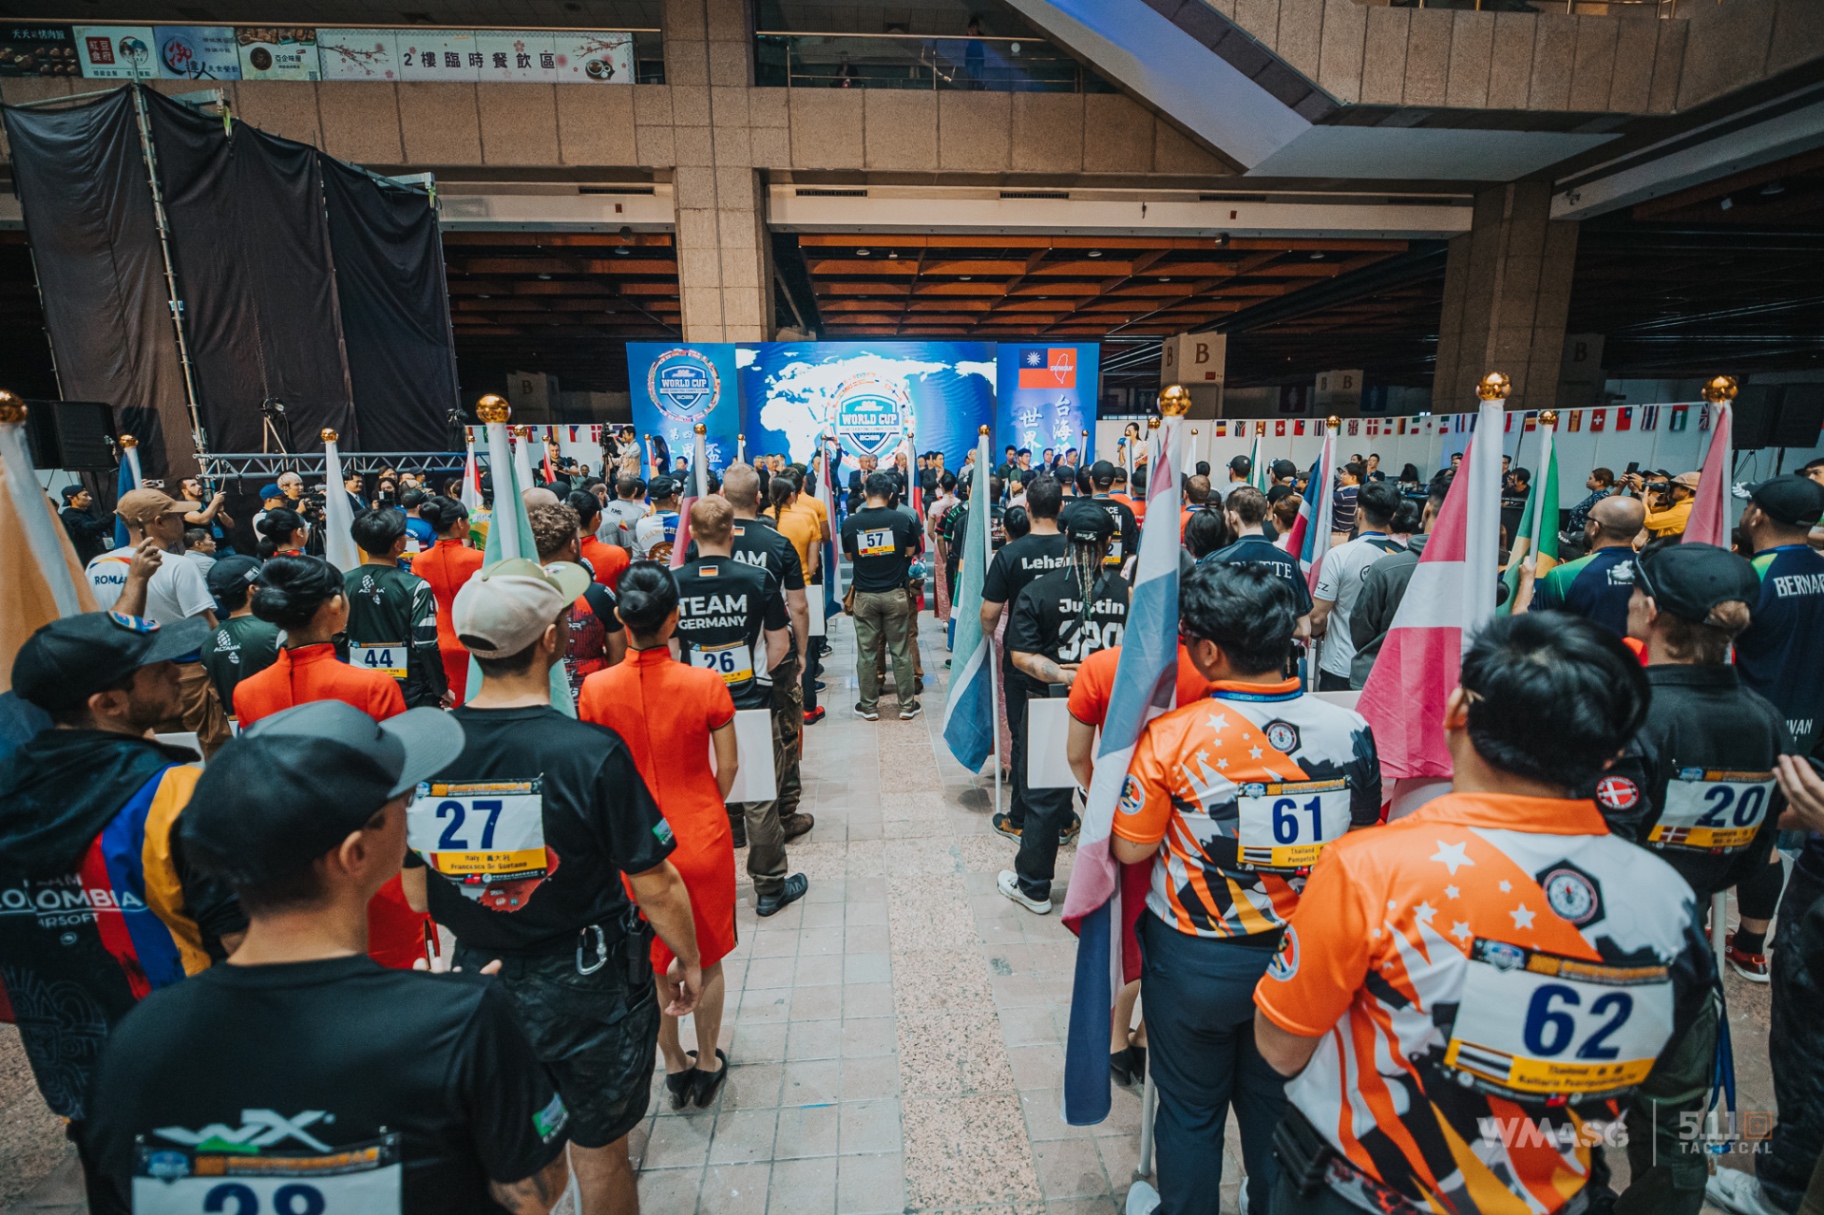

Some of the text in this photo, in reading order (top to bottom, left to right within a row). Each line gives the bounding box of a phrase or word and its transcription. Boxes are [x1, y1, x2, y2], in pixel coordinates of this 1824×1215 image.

[403, 52, 556, 70] 2樓臨時餐飲區
[1166, 346, 1174, 367] B
[1194, 343, 1210, 364] B
[1573, 342, 1588, 362] B
[521, 379, 533, 395] B
[661, 379, 707, 387] WORLD CUP
[1342, 375, 1353, 389] B
[842, 413, 897, 425] WORLD CUP
[866, 533, 884, 547] 57
[733, 550, 767, 568] AM
[679, 594, 748, 617] TEAM
[678, 616, 747, 630] GERMANY
[364, 649, 394, 668] 44
[704, 651, 735, 673] 26
[1695, 785, 1766, 827] 20
[436, 800, 503, 849] 27
[1272, 795, 1322, 845] 61
[1523, 983, 1634, 1060] 62
